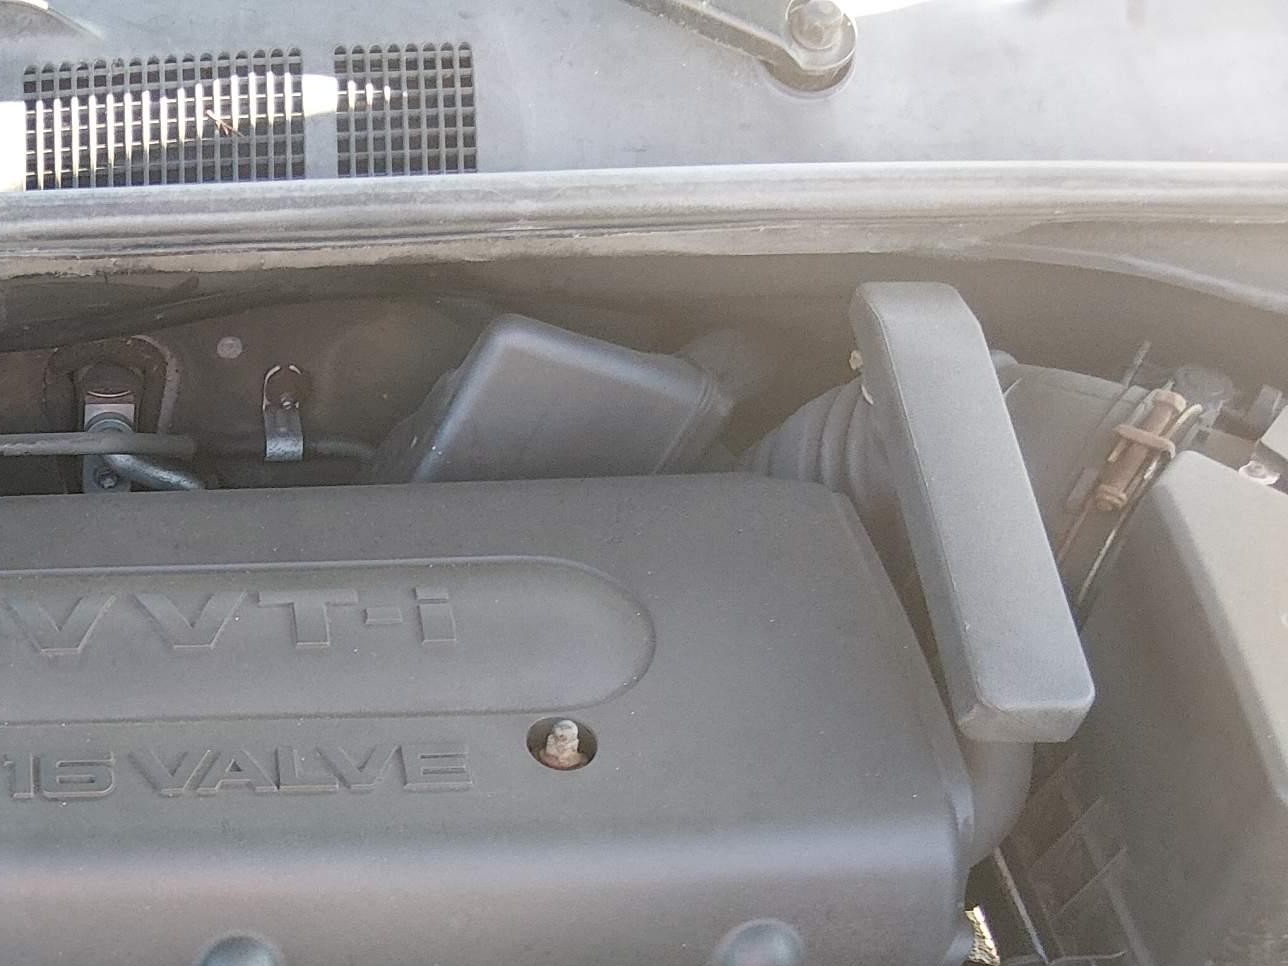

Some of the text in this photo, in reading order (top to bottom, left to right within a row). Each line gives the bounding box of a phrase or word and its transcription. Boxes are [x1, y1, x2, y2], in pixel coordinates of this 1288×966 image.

[12, 586, 458, 655] VVT-i
[3, 744, 475, 800] 16 VALVE
